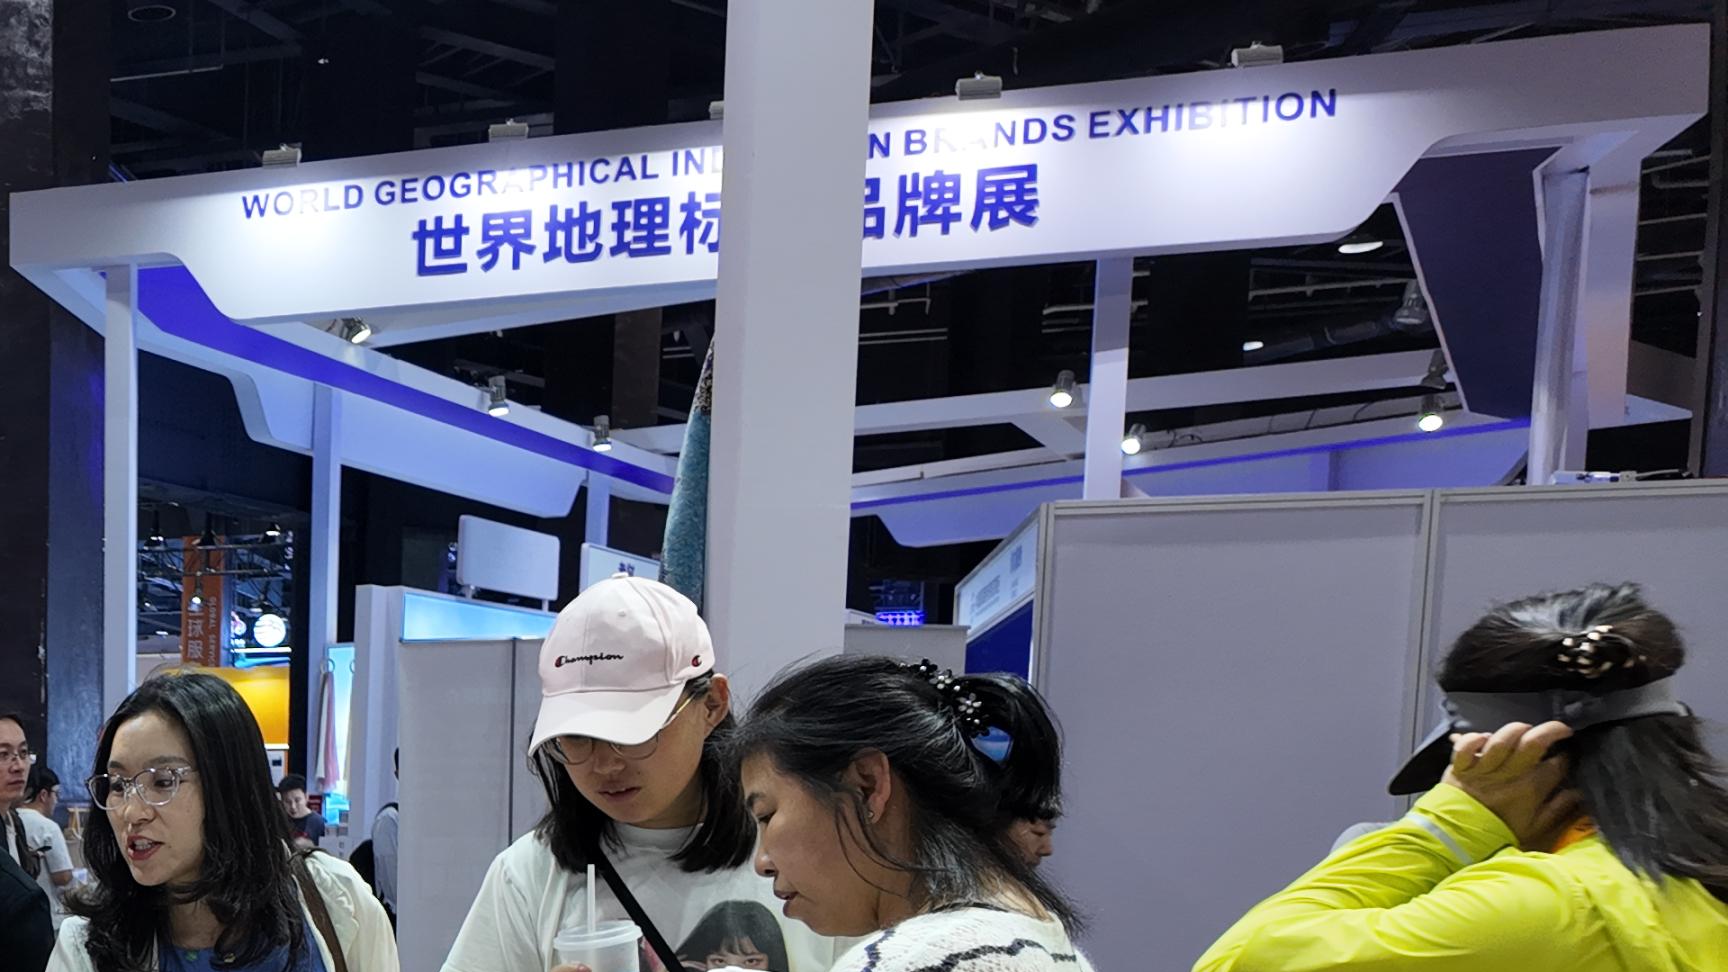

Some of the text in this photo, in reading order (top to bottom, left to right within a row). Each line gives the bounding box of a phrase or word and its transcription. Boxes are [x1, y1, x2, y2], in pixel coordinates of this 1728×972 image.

[242, 184, 364, 219] WORLD
[375, 154, 659, 207] GEOGRAPHICAL
[1088, 88, 1337, 140] EXHIBITION
[412, 190, 721, 278] 世界地理标
[554, 652, 624, 668] Champion
